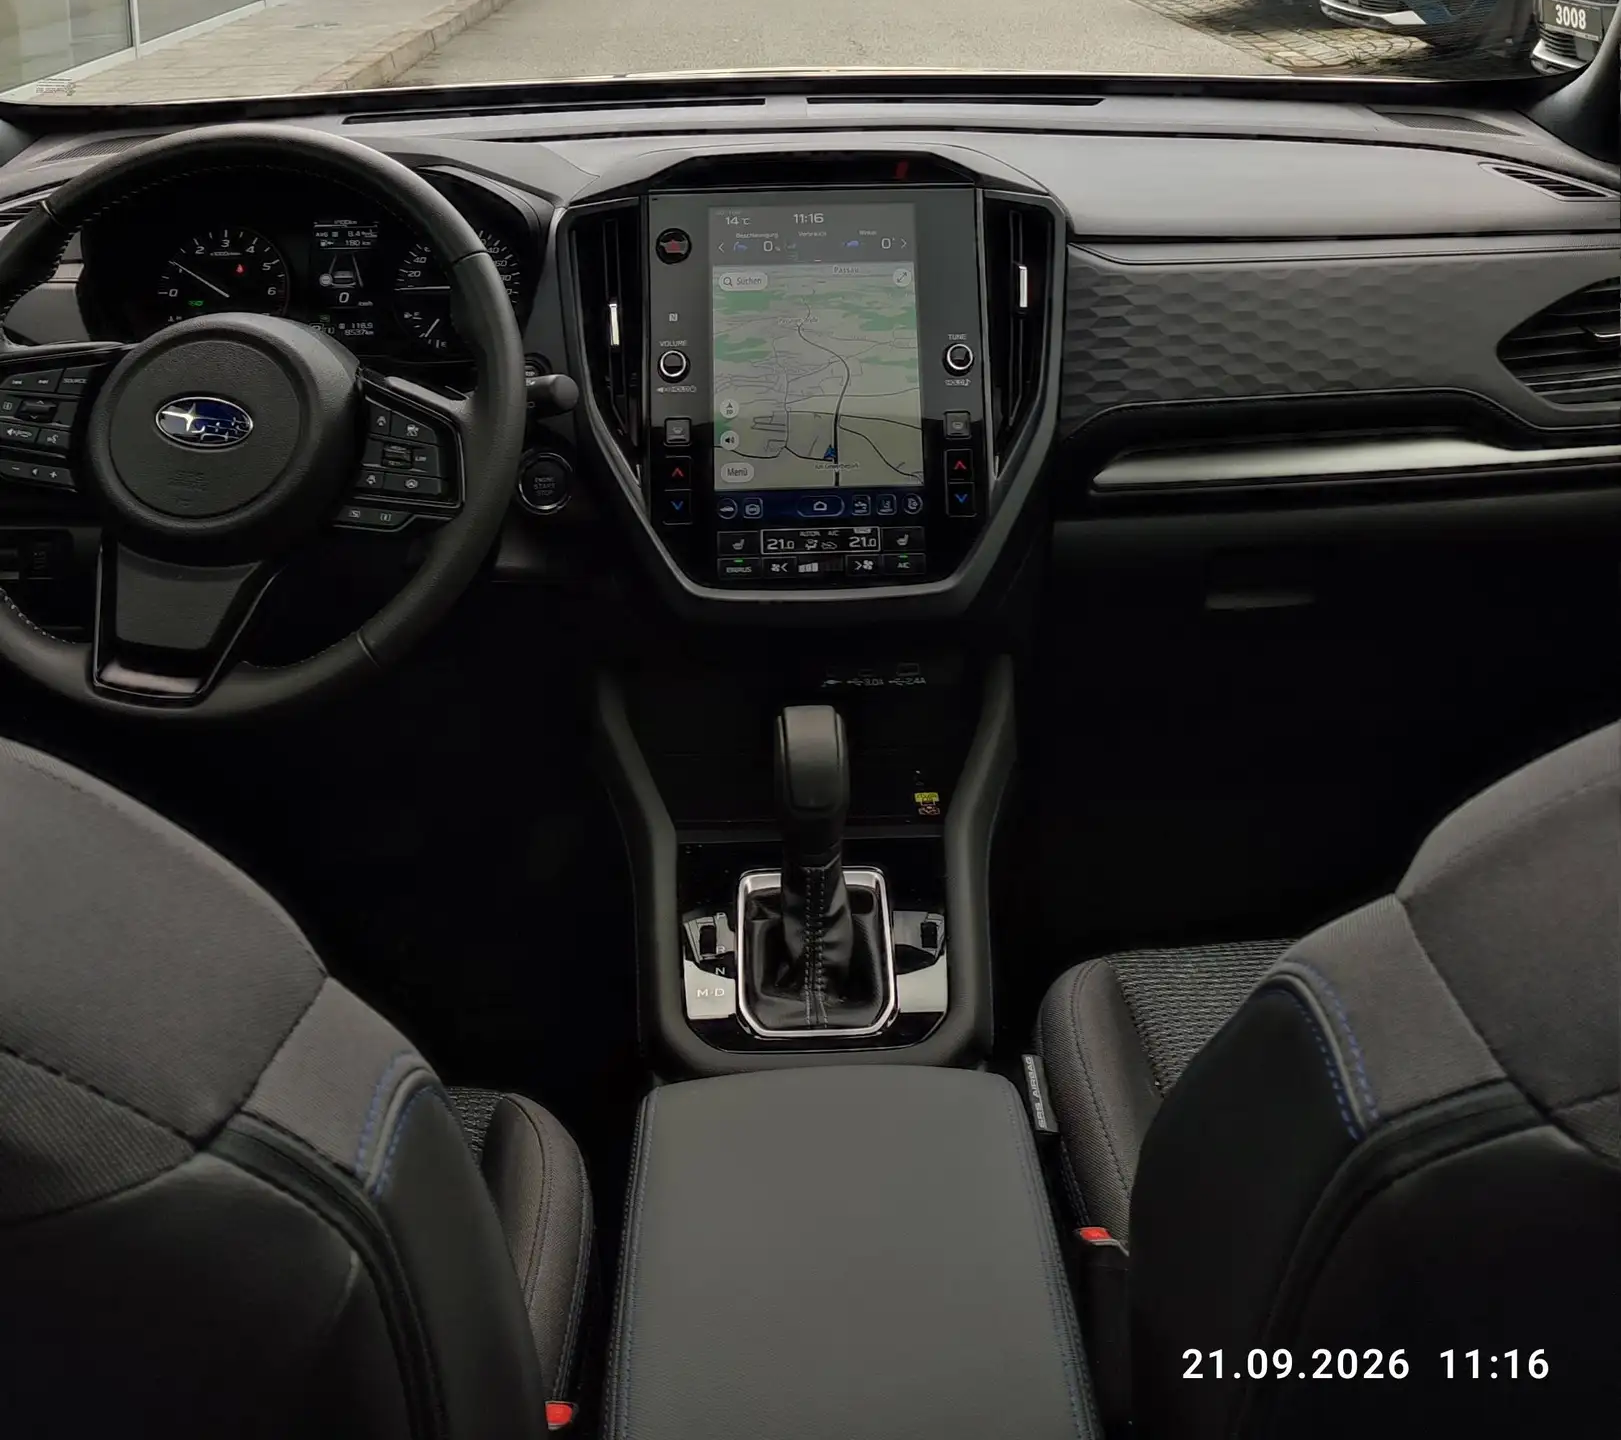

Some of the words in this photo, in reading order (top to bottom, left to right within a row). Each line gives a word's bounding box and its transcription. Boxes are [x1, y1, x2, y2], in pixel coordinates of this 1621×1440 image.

[1555, 4, 1587, 30] 3008
[725, 216, 739, 225] 14
[793, 213, 825, 224] 11:16
[220, 239, 231, 248] 3
[194, 246, 205, 255] 2
[412, 256, 428, 264] 40
[261, 262, 272, 271] 5
[833, 265, 860, 274] Passau
[407, 270, 422, 278] 20
[735, 274, 763, 286] Suchen
[168, 288, 179, 298] 0
[266, 287, 278, 296] 6
[338, 291, 350, 303] 0
[726, 467, 749, 478] Menü
[766, 538, 795, 550] 21.0
[848, 536, 877, 548] 21.0
[715, 967, 726, 976] N
[696, 988, 709, 998] M
[714, 988, 725, 997] D
[1025, 1056, 1041, 1098] AIRBAG
